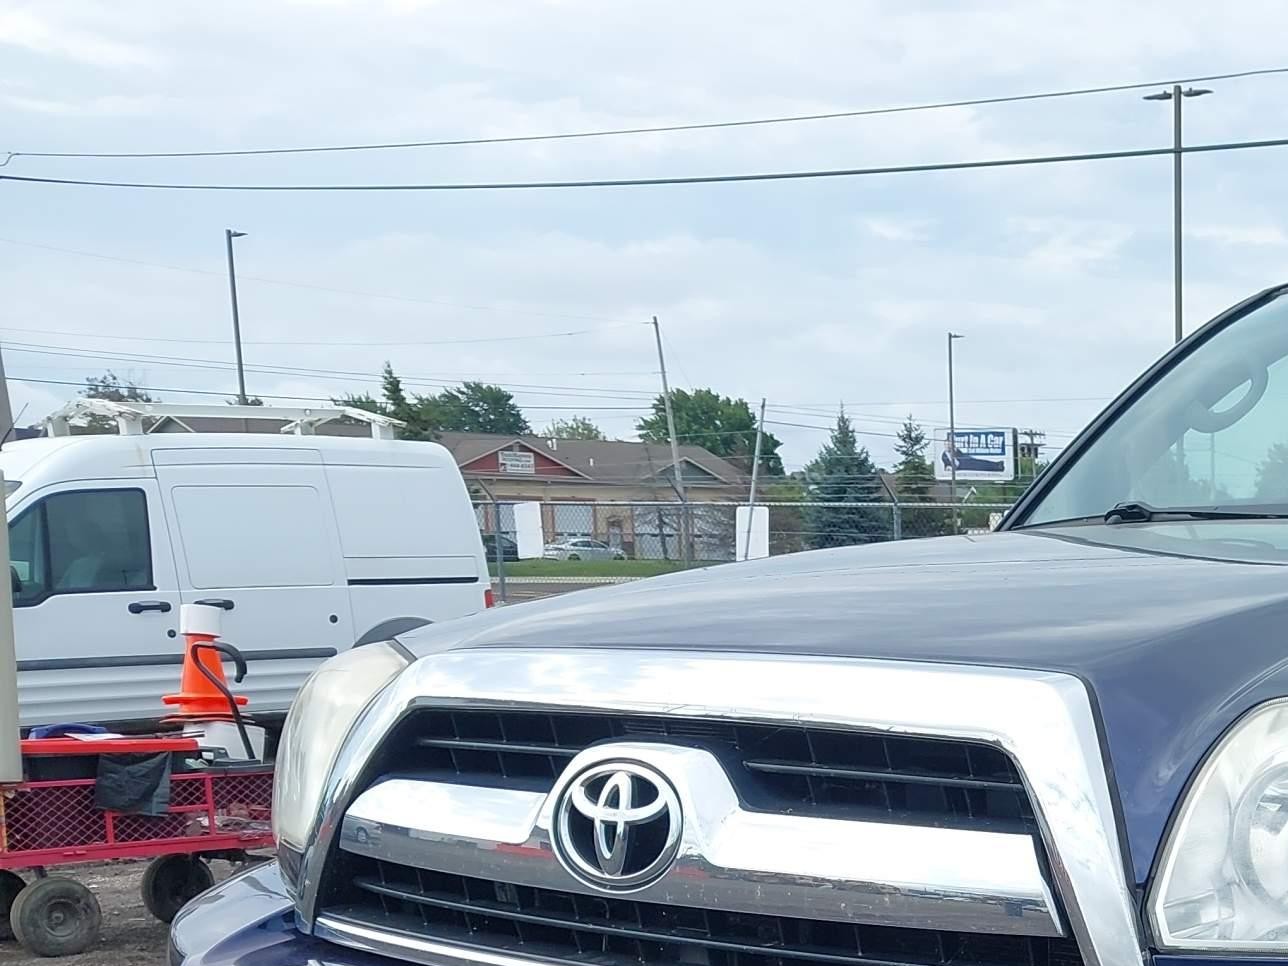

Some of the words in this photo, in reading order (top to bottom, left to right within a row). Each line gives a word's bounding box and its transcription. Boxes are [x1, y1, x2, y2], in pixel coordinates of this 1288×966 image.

[953, 434, 969, 448] urt
[980, 433, 987, 448] A
[987, 433, 1004, 448] Car
